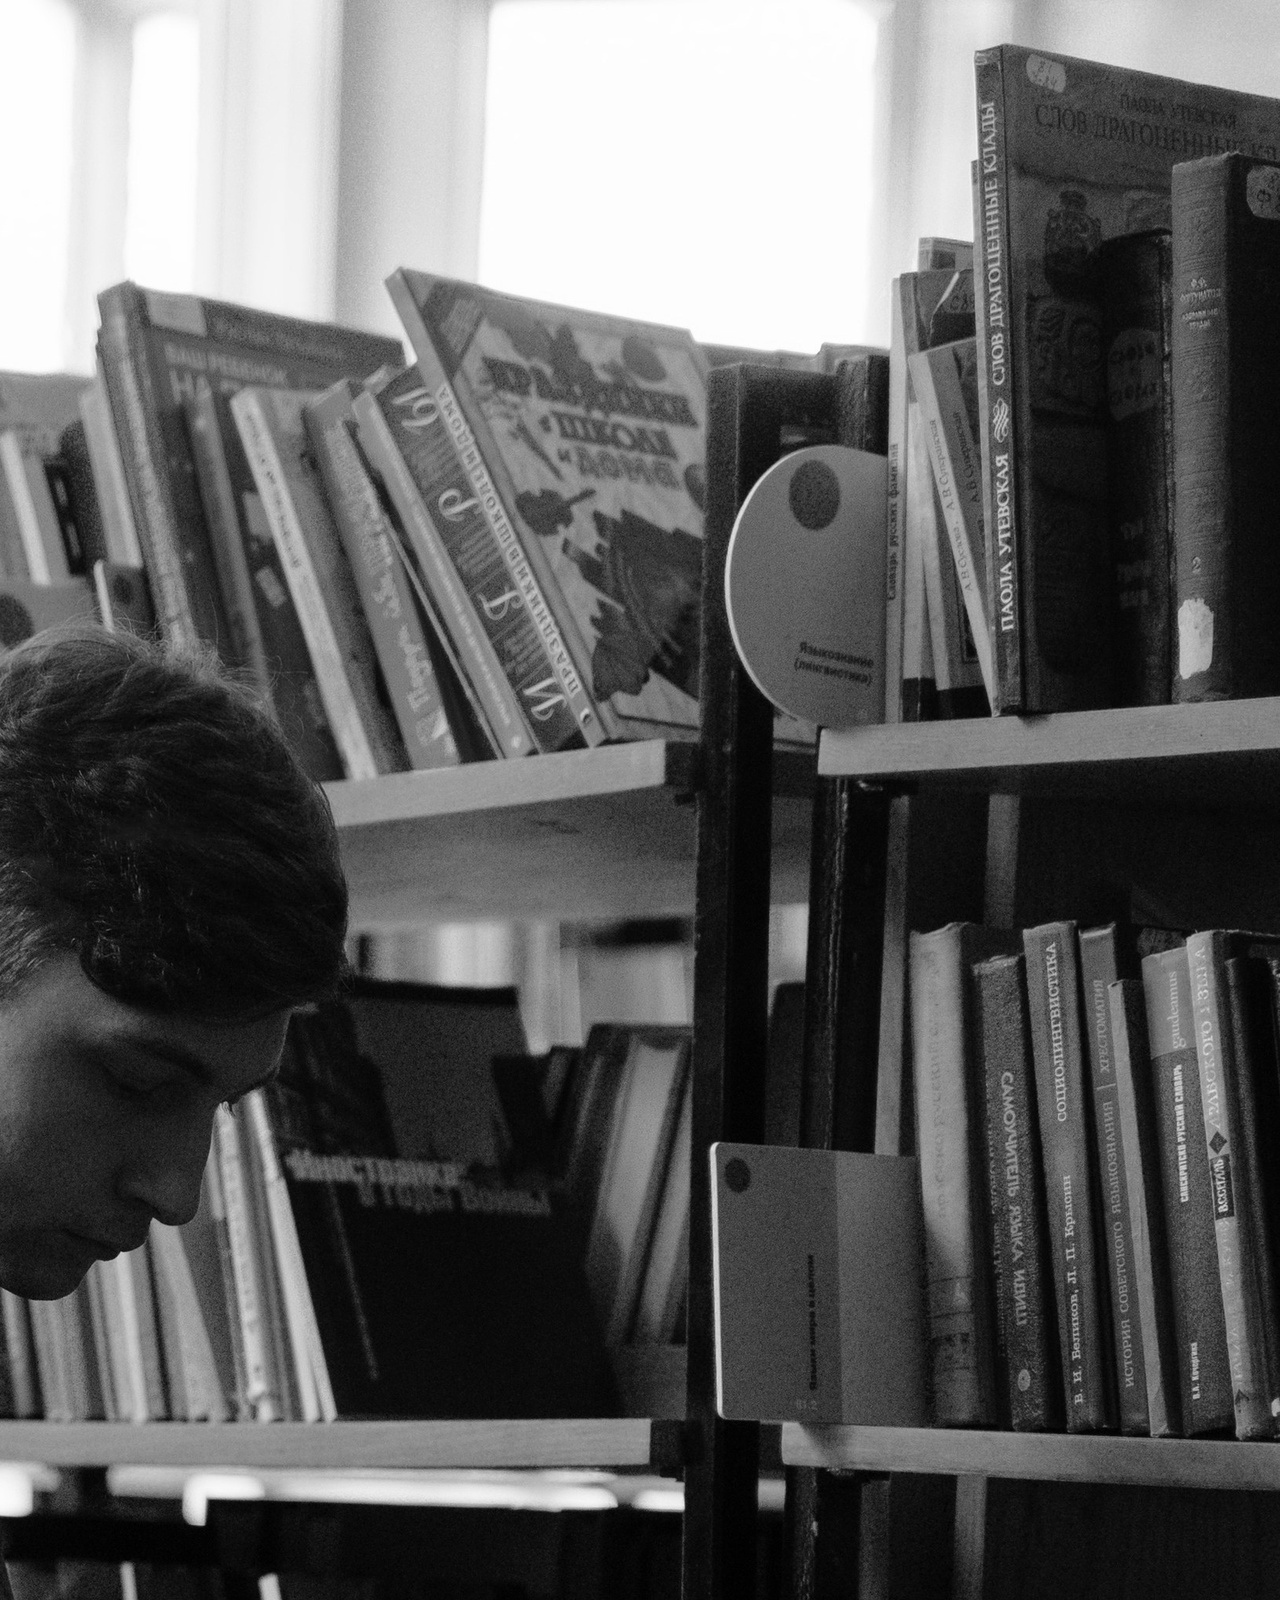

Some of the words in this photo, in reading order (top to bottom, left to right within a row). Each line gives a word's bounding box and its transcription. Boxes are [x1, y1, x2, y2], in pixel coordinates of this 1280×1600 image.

[980, 100, 999, 173] КЛАДЫ
[1034, 103, 1087, 134] СЛОВ
[983, 177, 1005, 327] ДРАГОЦЕННЫЕ
[990, 331, 1006, 386] СЛОВ
[433, 381, 476, 449] ДОМА
[461, 448, 482, 467] И
[469, 465, 517, 546] ШКОЛЕ
[888, 502, 899, 546] русских
[994, 453, 1012, 555] УТЕВСКАЯ
[504, 544, 524, 562] В
[510, 561, 584, 696] ПРАЗДНИКИ
[998, 561, 1015, 630] ПАОЛА
[1164, 970, 1187, 1049] gaudeamus
[1192, 946, 1210, 1014] ЗЫА
[1043, 942, 1071, 1122] СОЦИОЛИНГВИСТИКА
[1091, 979, 1111, 1073] ХРЕСТОМАТИЯ
[1172, 1064, 1182, 1102] СЛОВАРЬ
[997, 1070, 1021, 1197] САМОУЧИТЕЛЬ
[1101, 1101, 1122, 1214] ЯЗЫКОЗНАНИЯ
[1175, 1103, 1190, 1202] САНСКРИТСКО-РУССКИЙ
[1006, 1203, 1025, 1262] ЯЗЫКА
[1059, 1174, 1078, 1237] Крысин
[807, 1254, 815, 1298] целом
[1010, 1268, 1029, 1326] ИДИШ
[1111, 1220, 1130, 1313] СОВЕТСКОГО
[809, 1311, 817, 1345] мира
[1119, 1318, 1136, 1388] ИСТОРИЯ
[808, 1349, 817, 1390] Языки
